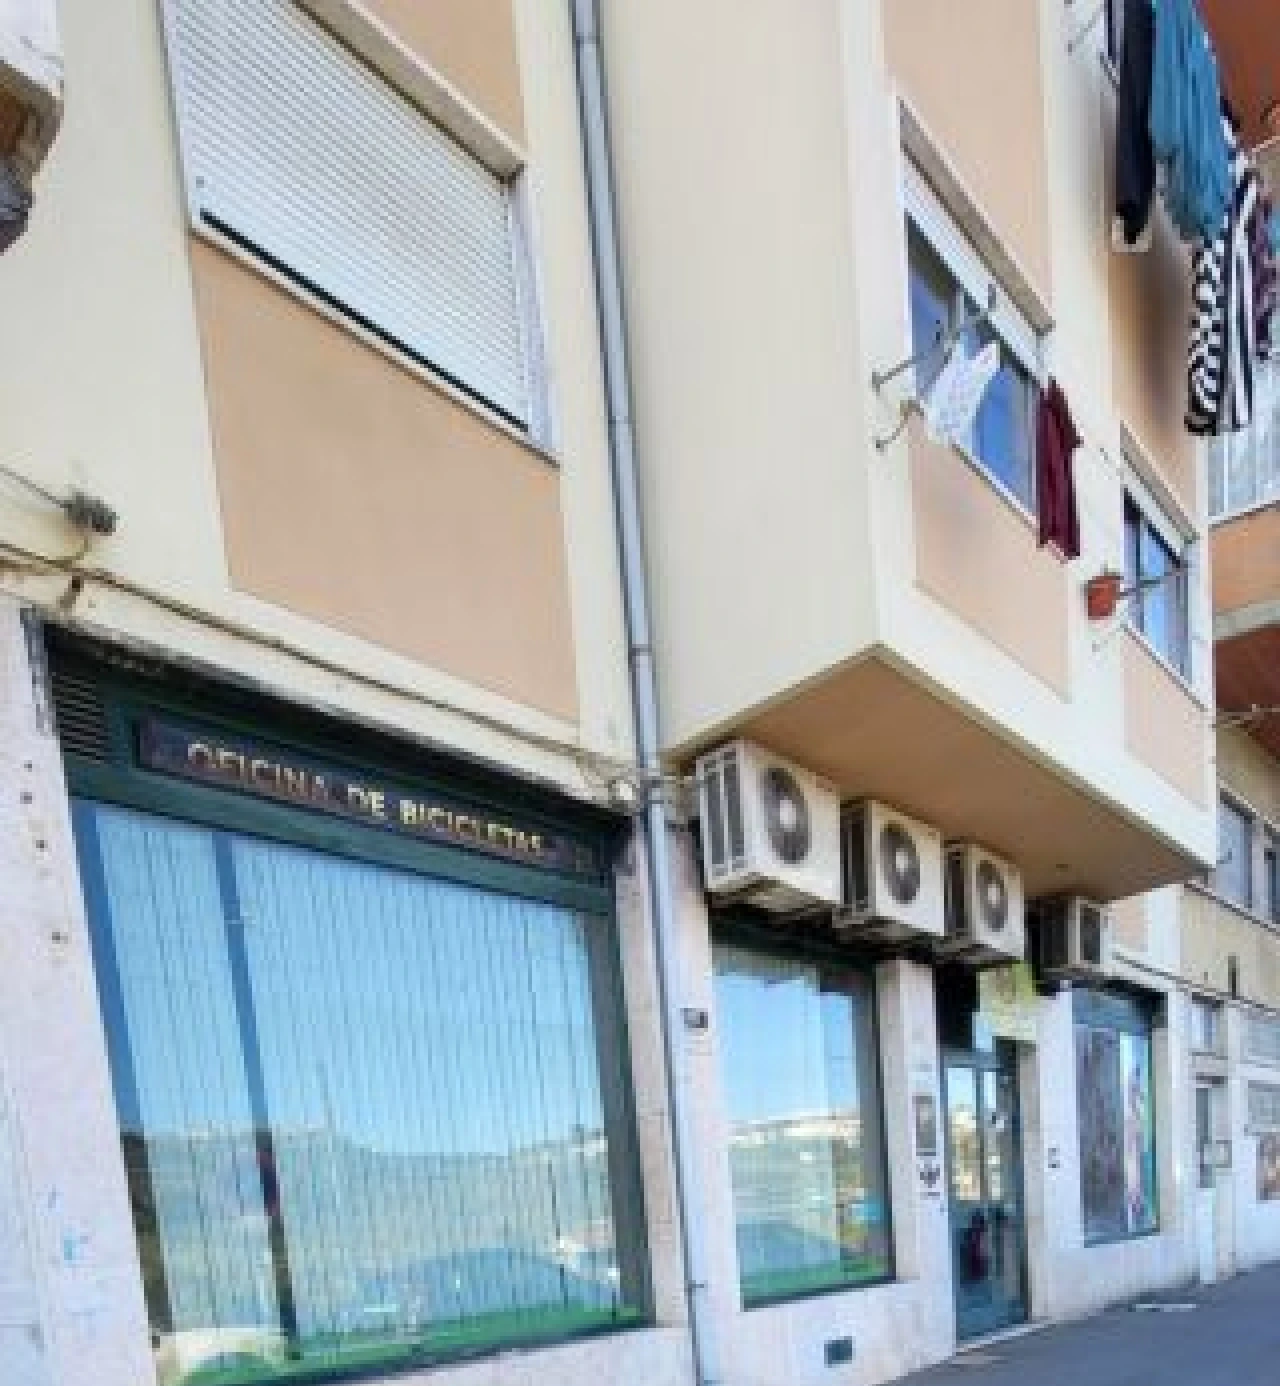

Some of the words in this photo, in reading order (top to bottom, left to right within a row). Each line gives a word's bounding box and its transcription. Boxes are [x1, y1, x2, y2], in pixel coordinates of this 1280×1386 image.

[187, 743, 329, 804] OFICINA
[347, 784, 387, 825] DE
[399, 799, 543, 857] BICICLETAS
